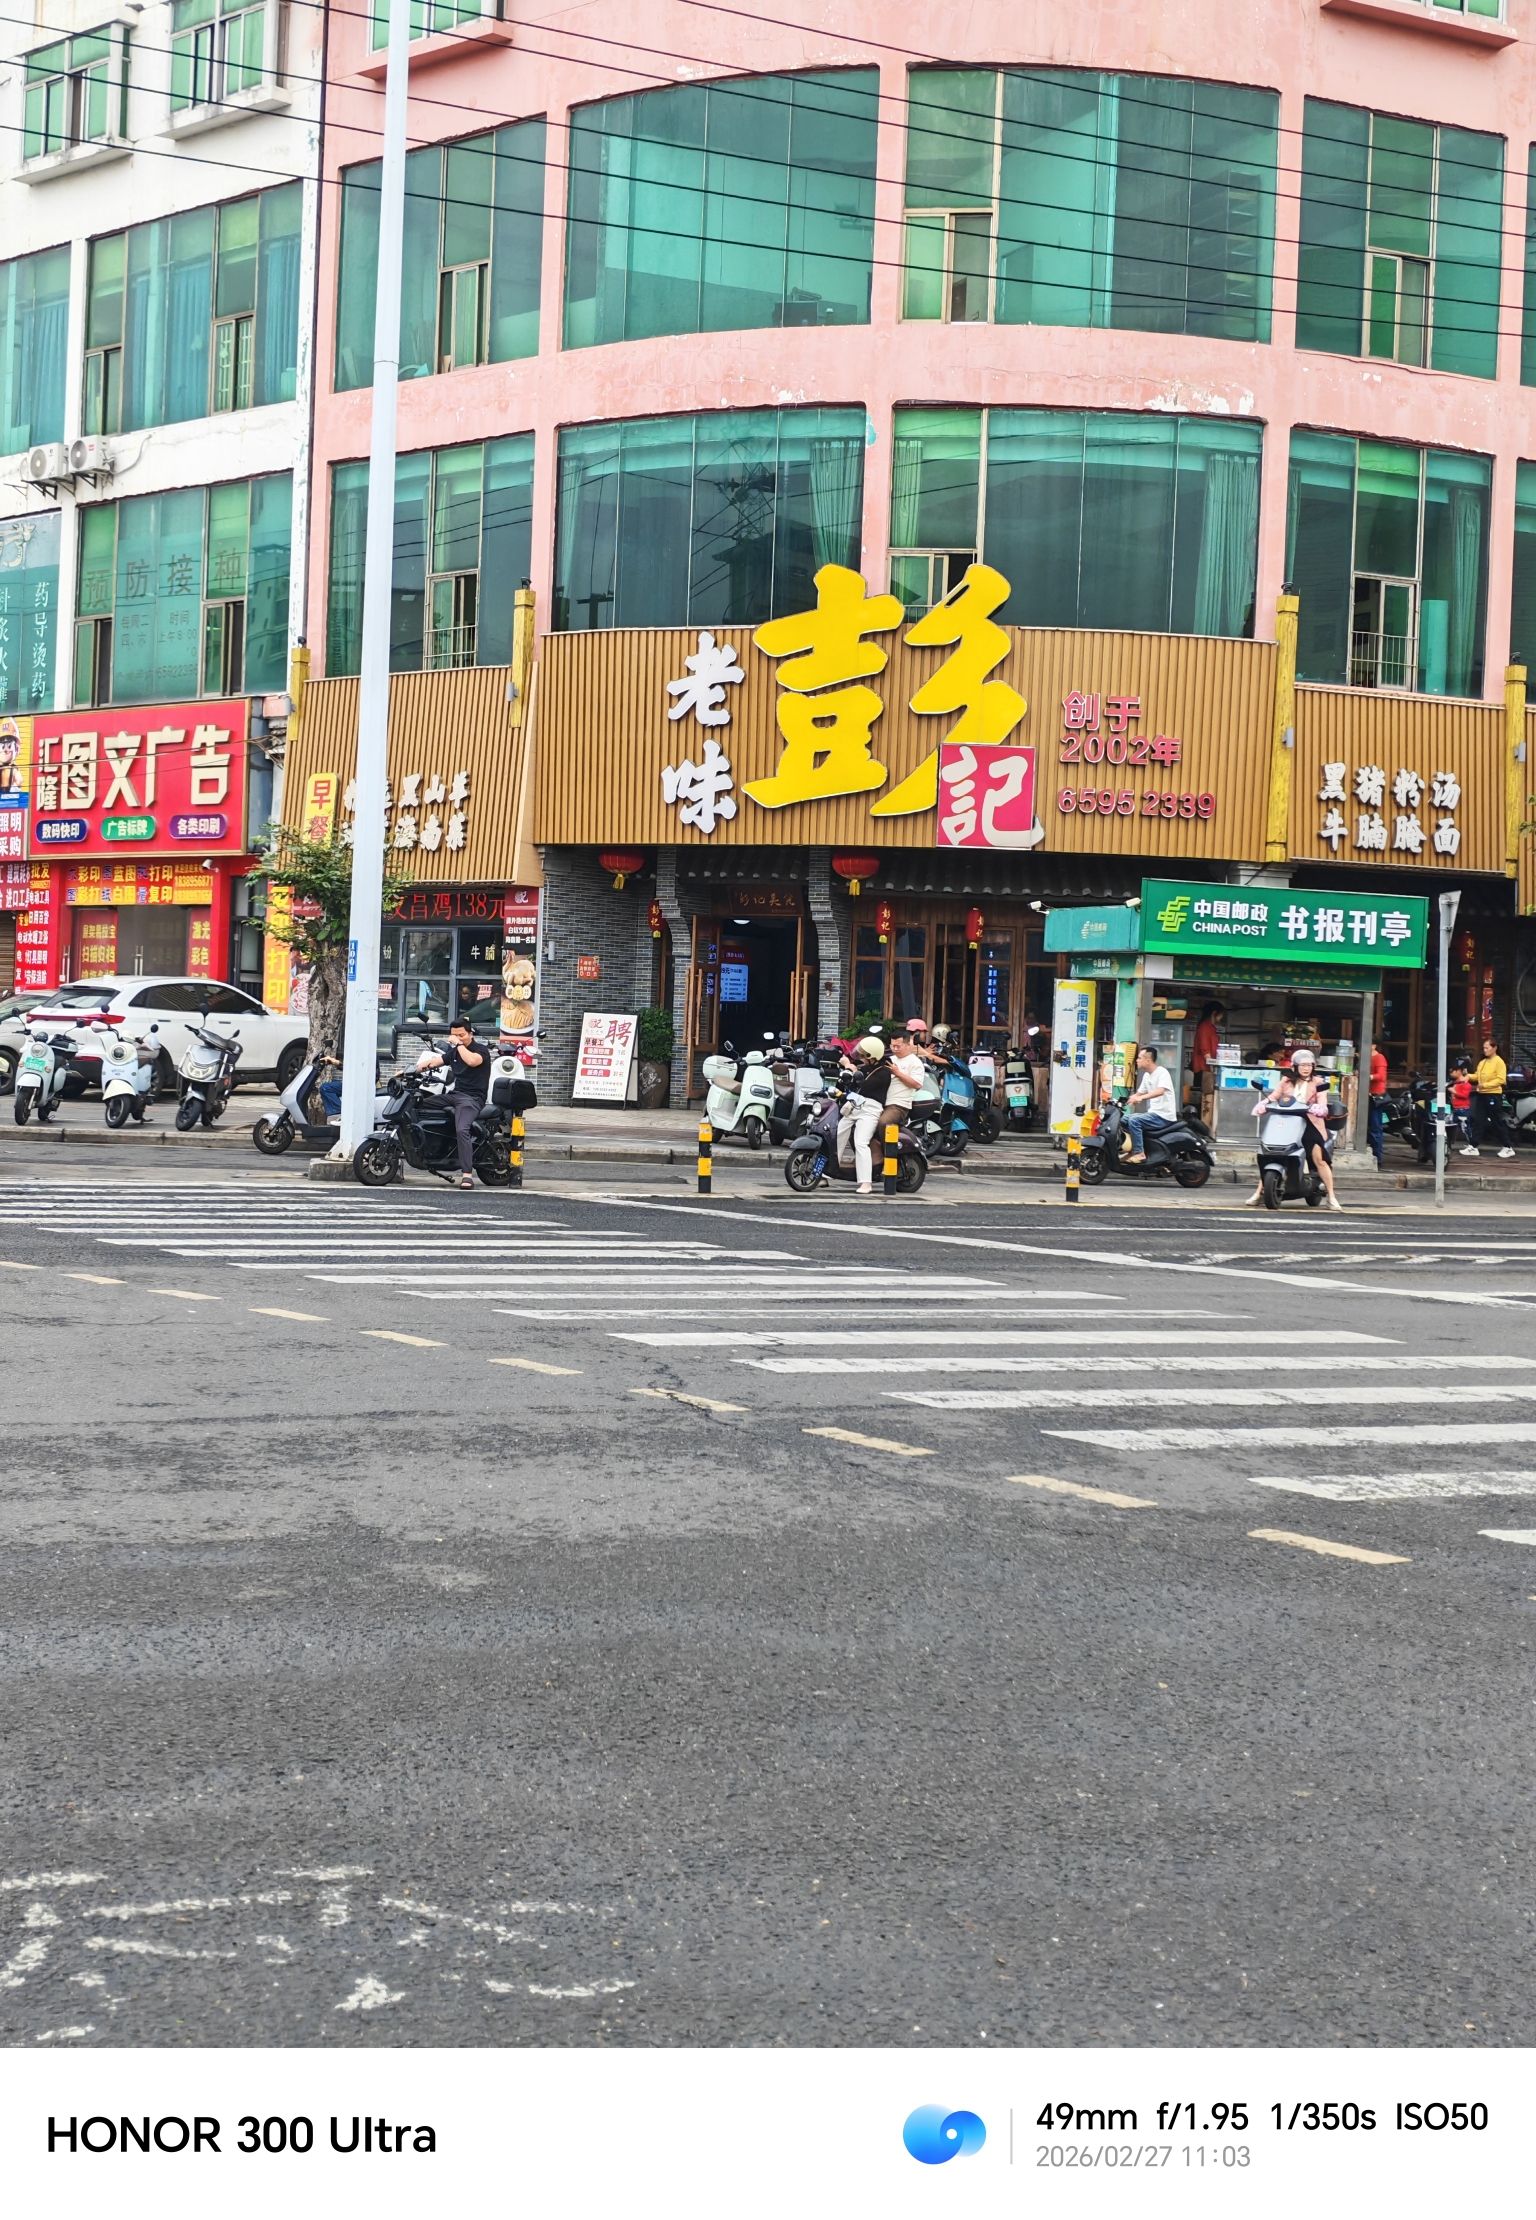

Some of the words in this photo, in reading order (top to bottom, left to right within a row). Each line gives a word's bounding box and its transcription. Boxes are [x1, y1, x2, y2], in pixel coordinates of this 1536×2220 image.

[85, 548, 241, 610] 预防接种
[1062, 690, 1142, 732] 创于
[661, 631, 745, 834] 老味
[1060, 731, 1182, 768] 2002年
[37, 737, 60, 812] 汇隆
[60, 724, 231, 811] 图文广告
[1319, 761, 1462, 811] 黑猪粉汤
[343, 770, 470, 812] 黑山羊
[941, 747, 1045, 848] 記
[41, 823, 80, 840] 数码快印
[107, 819, 148, 837] 广告标牌
[177, 816, 221, 836] 各类印刷
[1319, 807, 1463, 856] 牛腩腌面
[148, 864, 173, 883] 打印
[1192, 921, 1233, 935] CHINA
[1234, 924, 1268, 937] POST
[1193, 899, 1269, 923] 中国邮政
[1278, 904, 1412, 947] 书报刊亭
[605, 1019, 633, 1048] 聘
